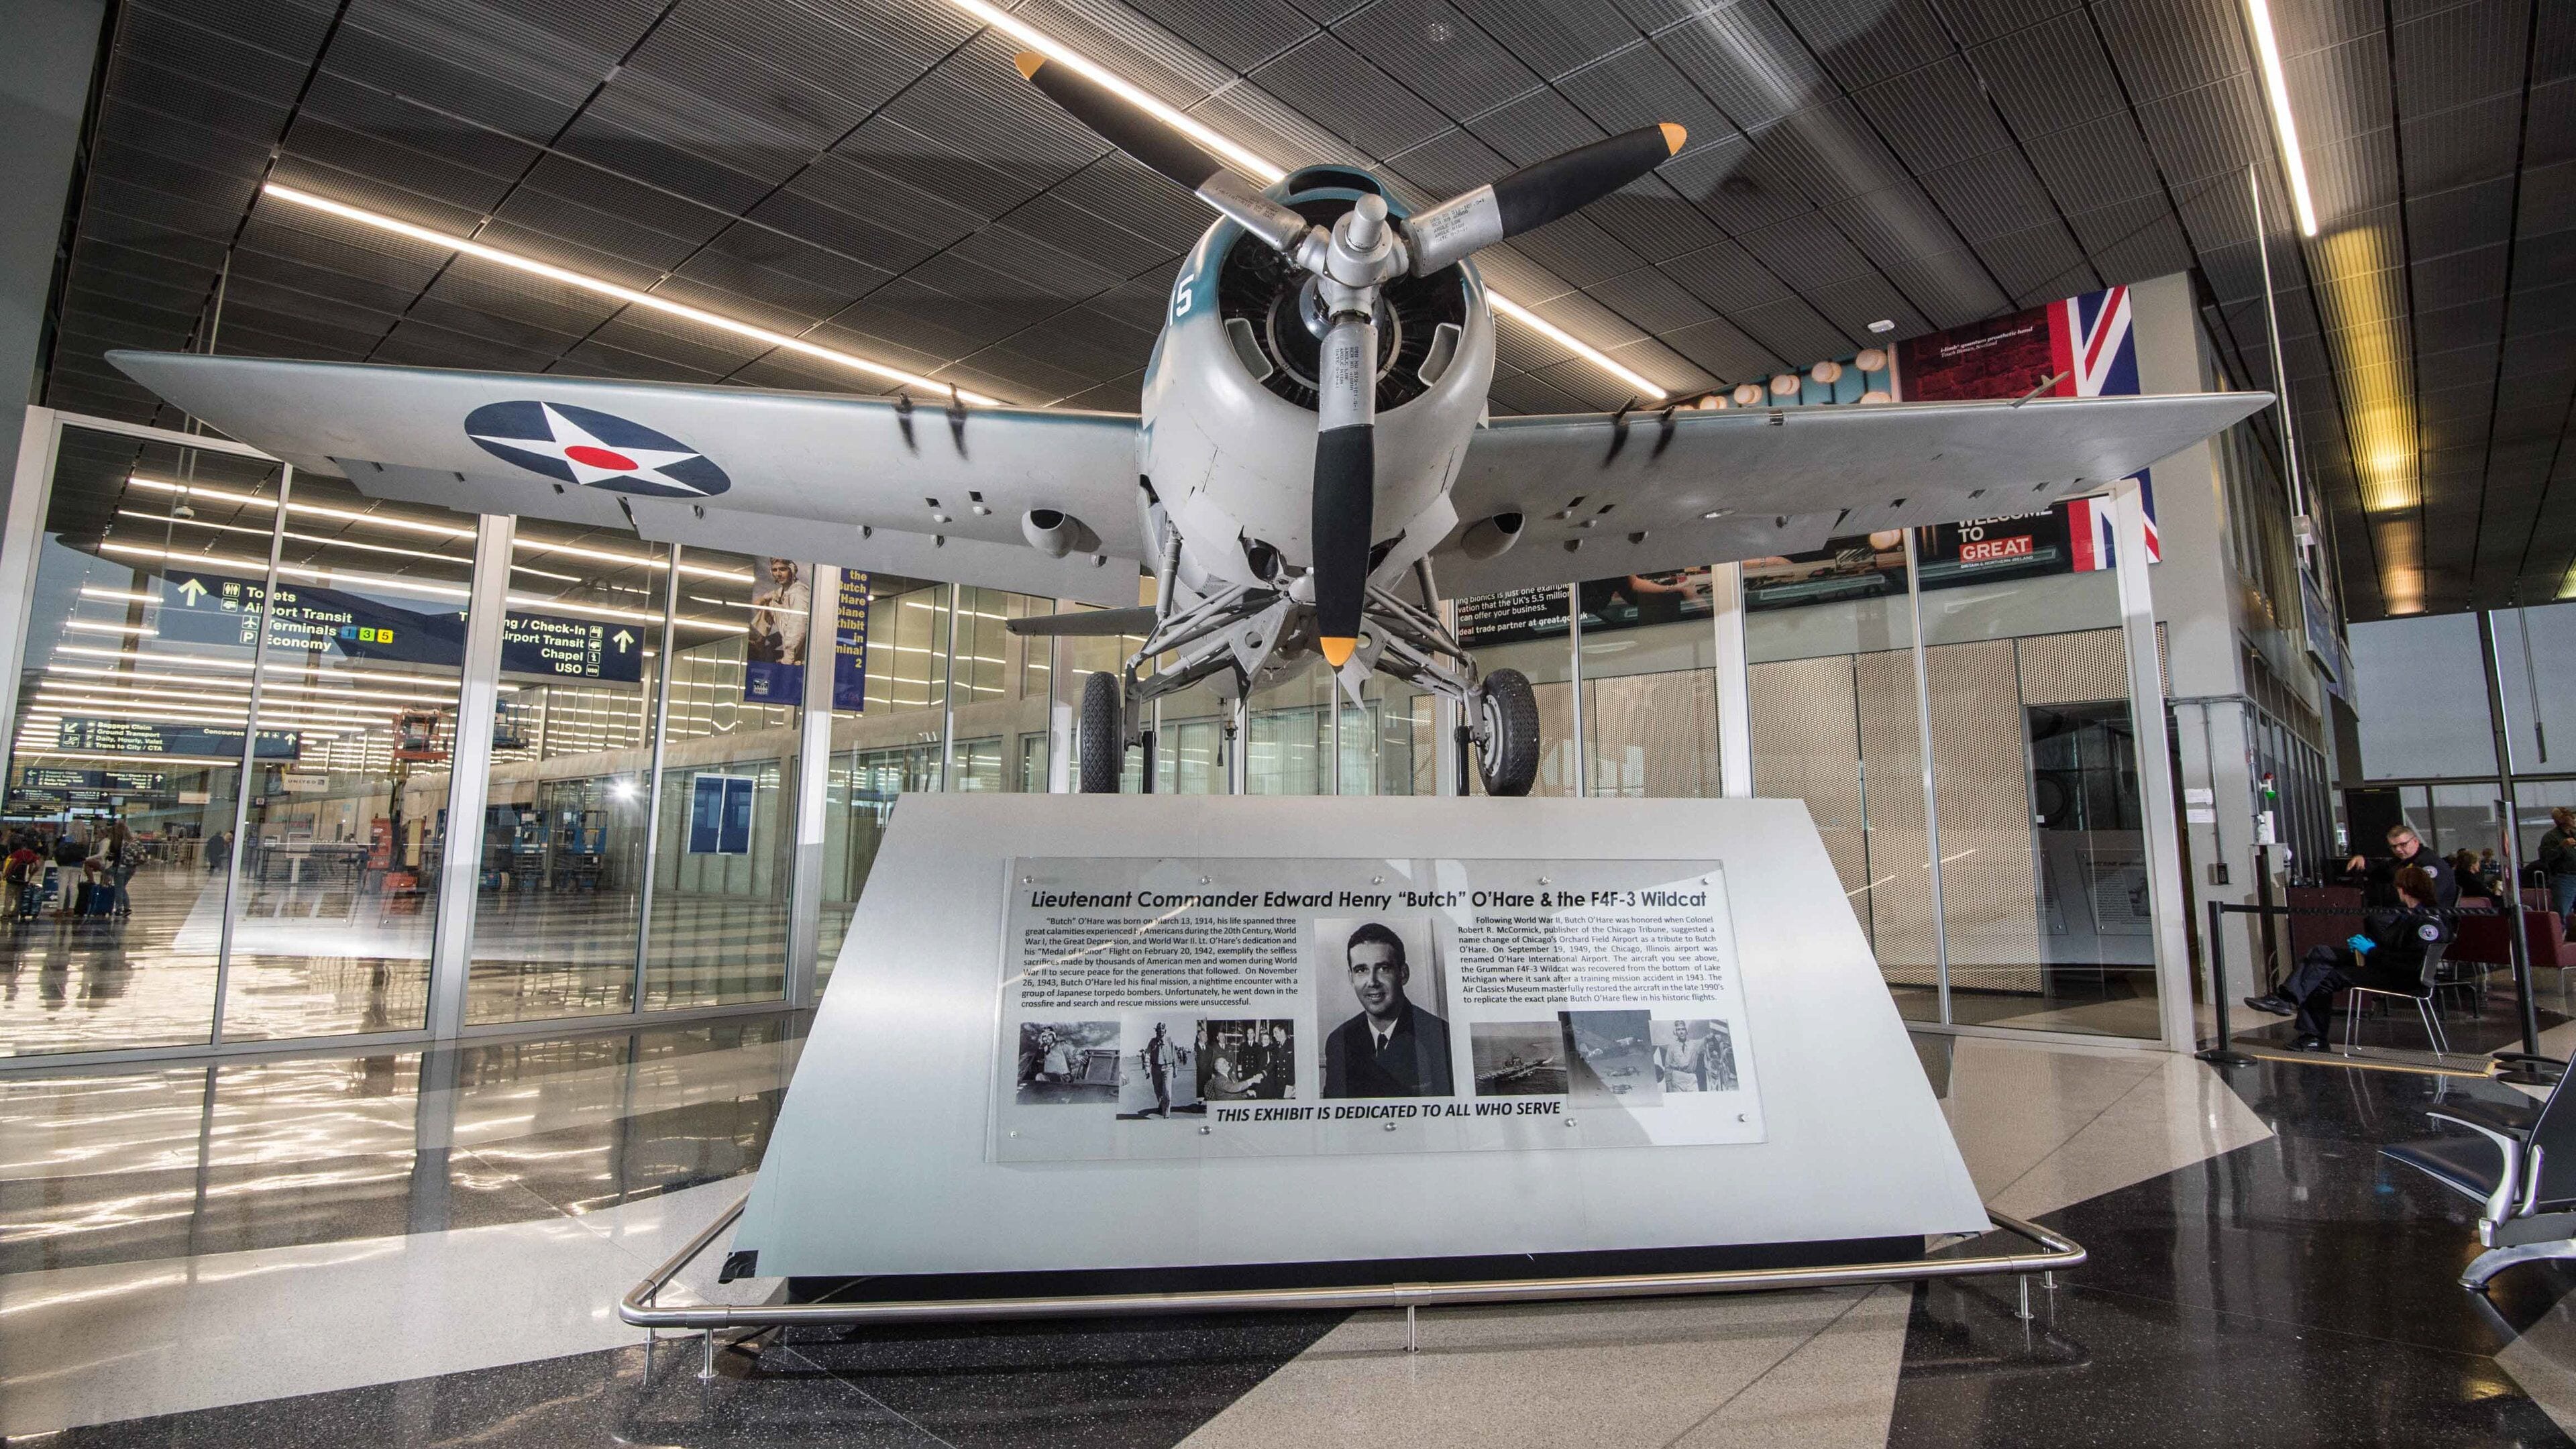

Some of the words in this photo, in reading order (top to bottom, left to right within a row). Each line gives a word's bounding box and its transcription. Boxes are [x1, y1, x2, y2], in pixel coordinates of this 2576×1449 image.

[2017, 326, 2033, 335] hand
[1958, 527, 1984, 543] TO
[1962, 537, 2029, 560] GREAT
[850, 570, 867, 581] the
[246, 586, 297, 602] Toets
[1470, 594, 1495, 603] bionics
[1505, 590, 1519, 600] just
[1521, 586, 1535, 596] one
[1482, 602, 1496, 611] that
[1499, 600, 1511, 609] the
[1513, 596, 1529, 606] UK's
[1532, 594, 1544, 603] 5.5
[303, 608, 352, 624] Transit
[1460, 614, 1472, 622] can
[1474, 611, 1491, 620] offer
[1493, 610, 1510, 619] your
[1512, 604, 1547, 615] business.
[531, 620, 586, 636] Check-In
[1458, 627, 1474, 636] deal
[1476, 625, 1495, 634] trade
[1497, 621, 1526, 632] partner
[363, 630, 370, 639] 3
[382, 631, 389, 641] 5
[502, 631, 539, 644] irport
[543, 635, 584, 649] Transit
[853, 633, 863, 643] in
[541, 648, 584, 661] Chapel
[555, 662, 582, 674] USO
[855, 658, 862, 668] 2
[97, 722, 129, 730] Baggage
[203, 729, 245, 737] Concourses
[1030, 891, 1132, 908] Lieutenant
[1138, 891, 1258, 908] Commander
[1263, 891, 1333, 908] Edward
[1339, 891, 1391, 911] Henry
[1540, 892, 1553, 907] &
[1557, 891, 1586, 907] the
[1591, 892, 1635, 907] F4F-3
[1641, 891, 1707, 907] Wildcat
[1476, 917, 1512, 925] Following
[1544, 926, 1578, 934] publisher
[1607, 926, 1636, 934] Chicago
[1639, 926, 1669, 934] Tribune,
[1671, 926, 1707, 934] suggested
[1037, 979, 1058, 987] 1943,
[1199, 977, 1232, 986] nightime
[1057, 989, 1092, 998] Japanese
[1094, 989, 1125, 998] torpedo
[1165, 988, 1220, 997] Unfortunately,
[1216, 1109, 1250, 1122] THIS
[1254, 1108, 1314, 1122] EXHIBIT
[1317, 1107, 1331, 1120] IS
[1334, 1105, 1417, 1120] DEDICATED
[1423, 1104, 1442, 1117] TO
[1445, 1104, 1470, 1116] ALL
[1474, 1103, 1512, 1116] WHO
[1516, 1102, 1561, 1116] SERVE
